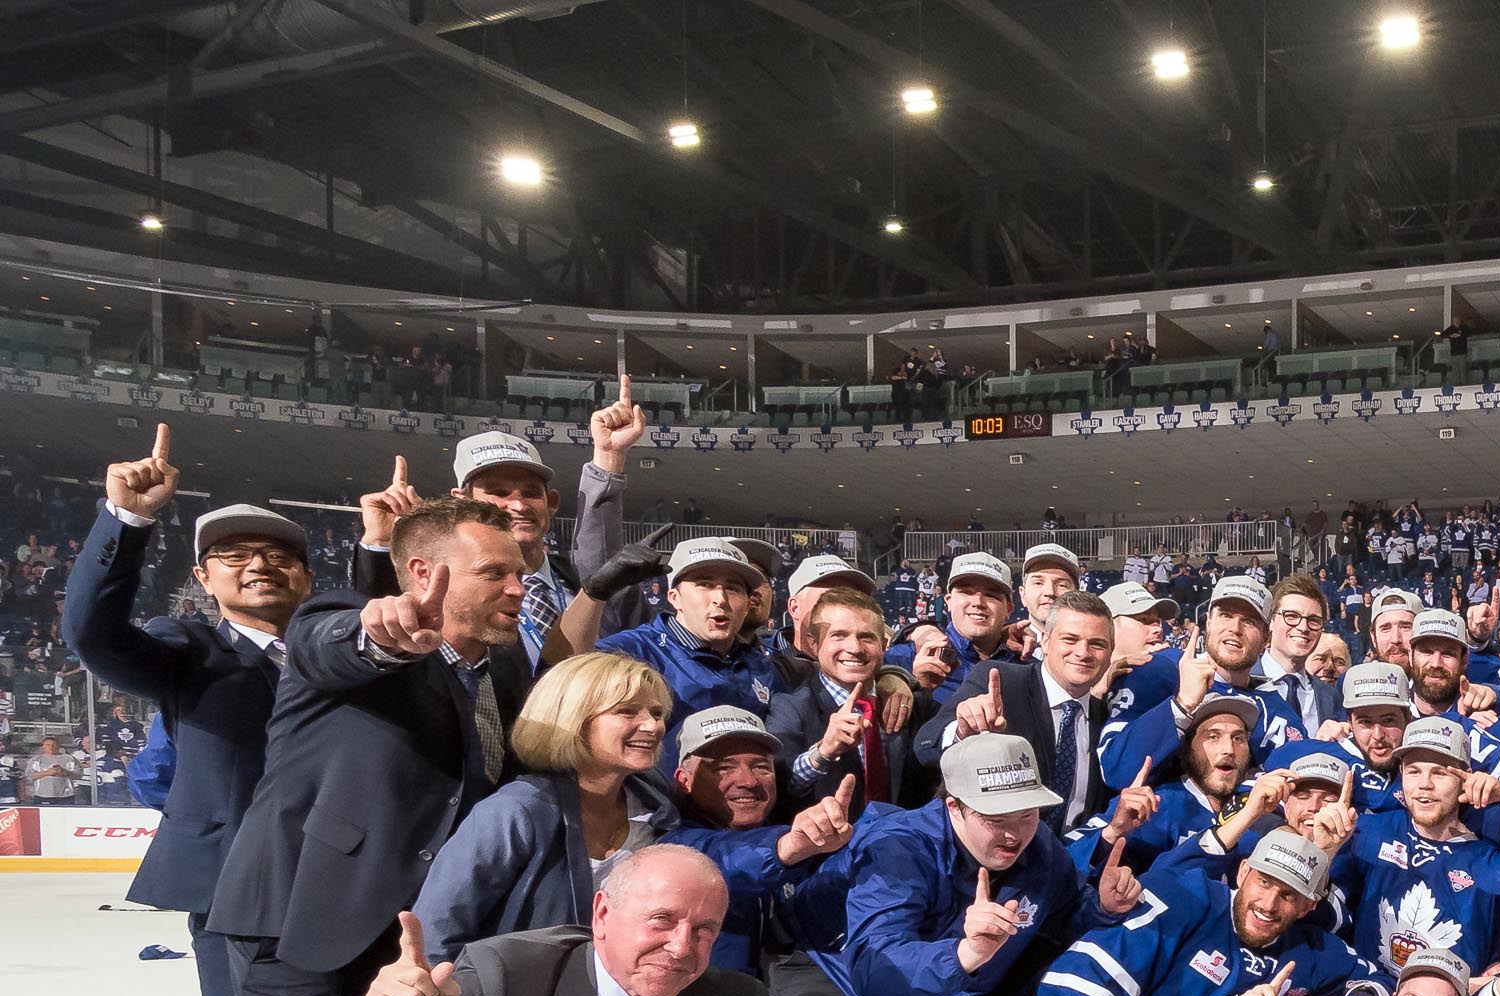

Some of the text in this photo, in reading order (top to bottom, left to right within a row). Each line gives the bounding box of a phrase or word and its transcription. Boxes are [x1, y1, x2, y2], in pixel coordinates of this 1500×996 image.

[132, 391, 158, 402] ELLIS
[1397, 397, 1418, 407] DOWIE
[1435, 394, 1461, 405] THOMAS
[232, 401, 262, 412] BOYER
[1314, 403, 1338, 413] HIGGINS
[1353, 399, 1381, 410] GRAHAM
[391, 416, 418, 427] SMITH
[1114, 416, 1144, 425] KASZYCKI
[1160, 414, 1178, 424] GAVIN
[1194, 411, 1217, 421] HARRIS
[971, 417, 1003, 434] 10:03
[1014, 414, 1042, 430] ESQ
[1073, 420, 1099, 429] STAMLER
[527, 427, 553, 436] BYERS
[934, 428, 962, 438] ANDERSON
[694, 433, 716, 442] EVANS
[1355, 683, 1399, 694] CHAMPIONS
[1259, 715, 1288, 749] A
[1408, 733, 1451, 746] CHAMPIONS
[991, 764, 1013, 774] CALDER
[977, 768, 1036, 787] CHAMPIONS
[73, 827, 158, 838] CCM
[1266, 849, 1313, 879] CHAMPIONS
[1193, 959, 1224, 983] Scotiabank
